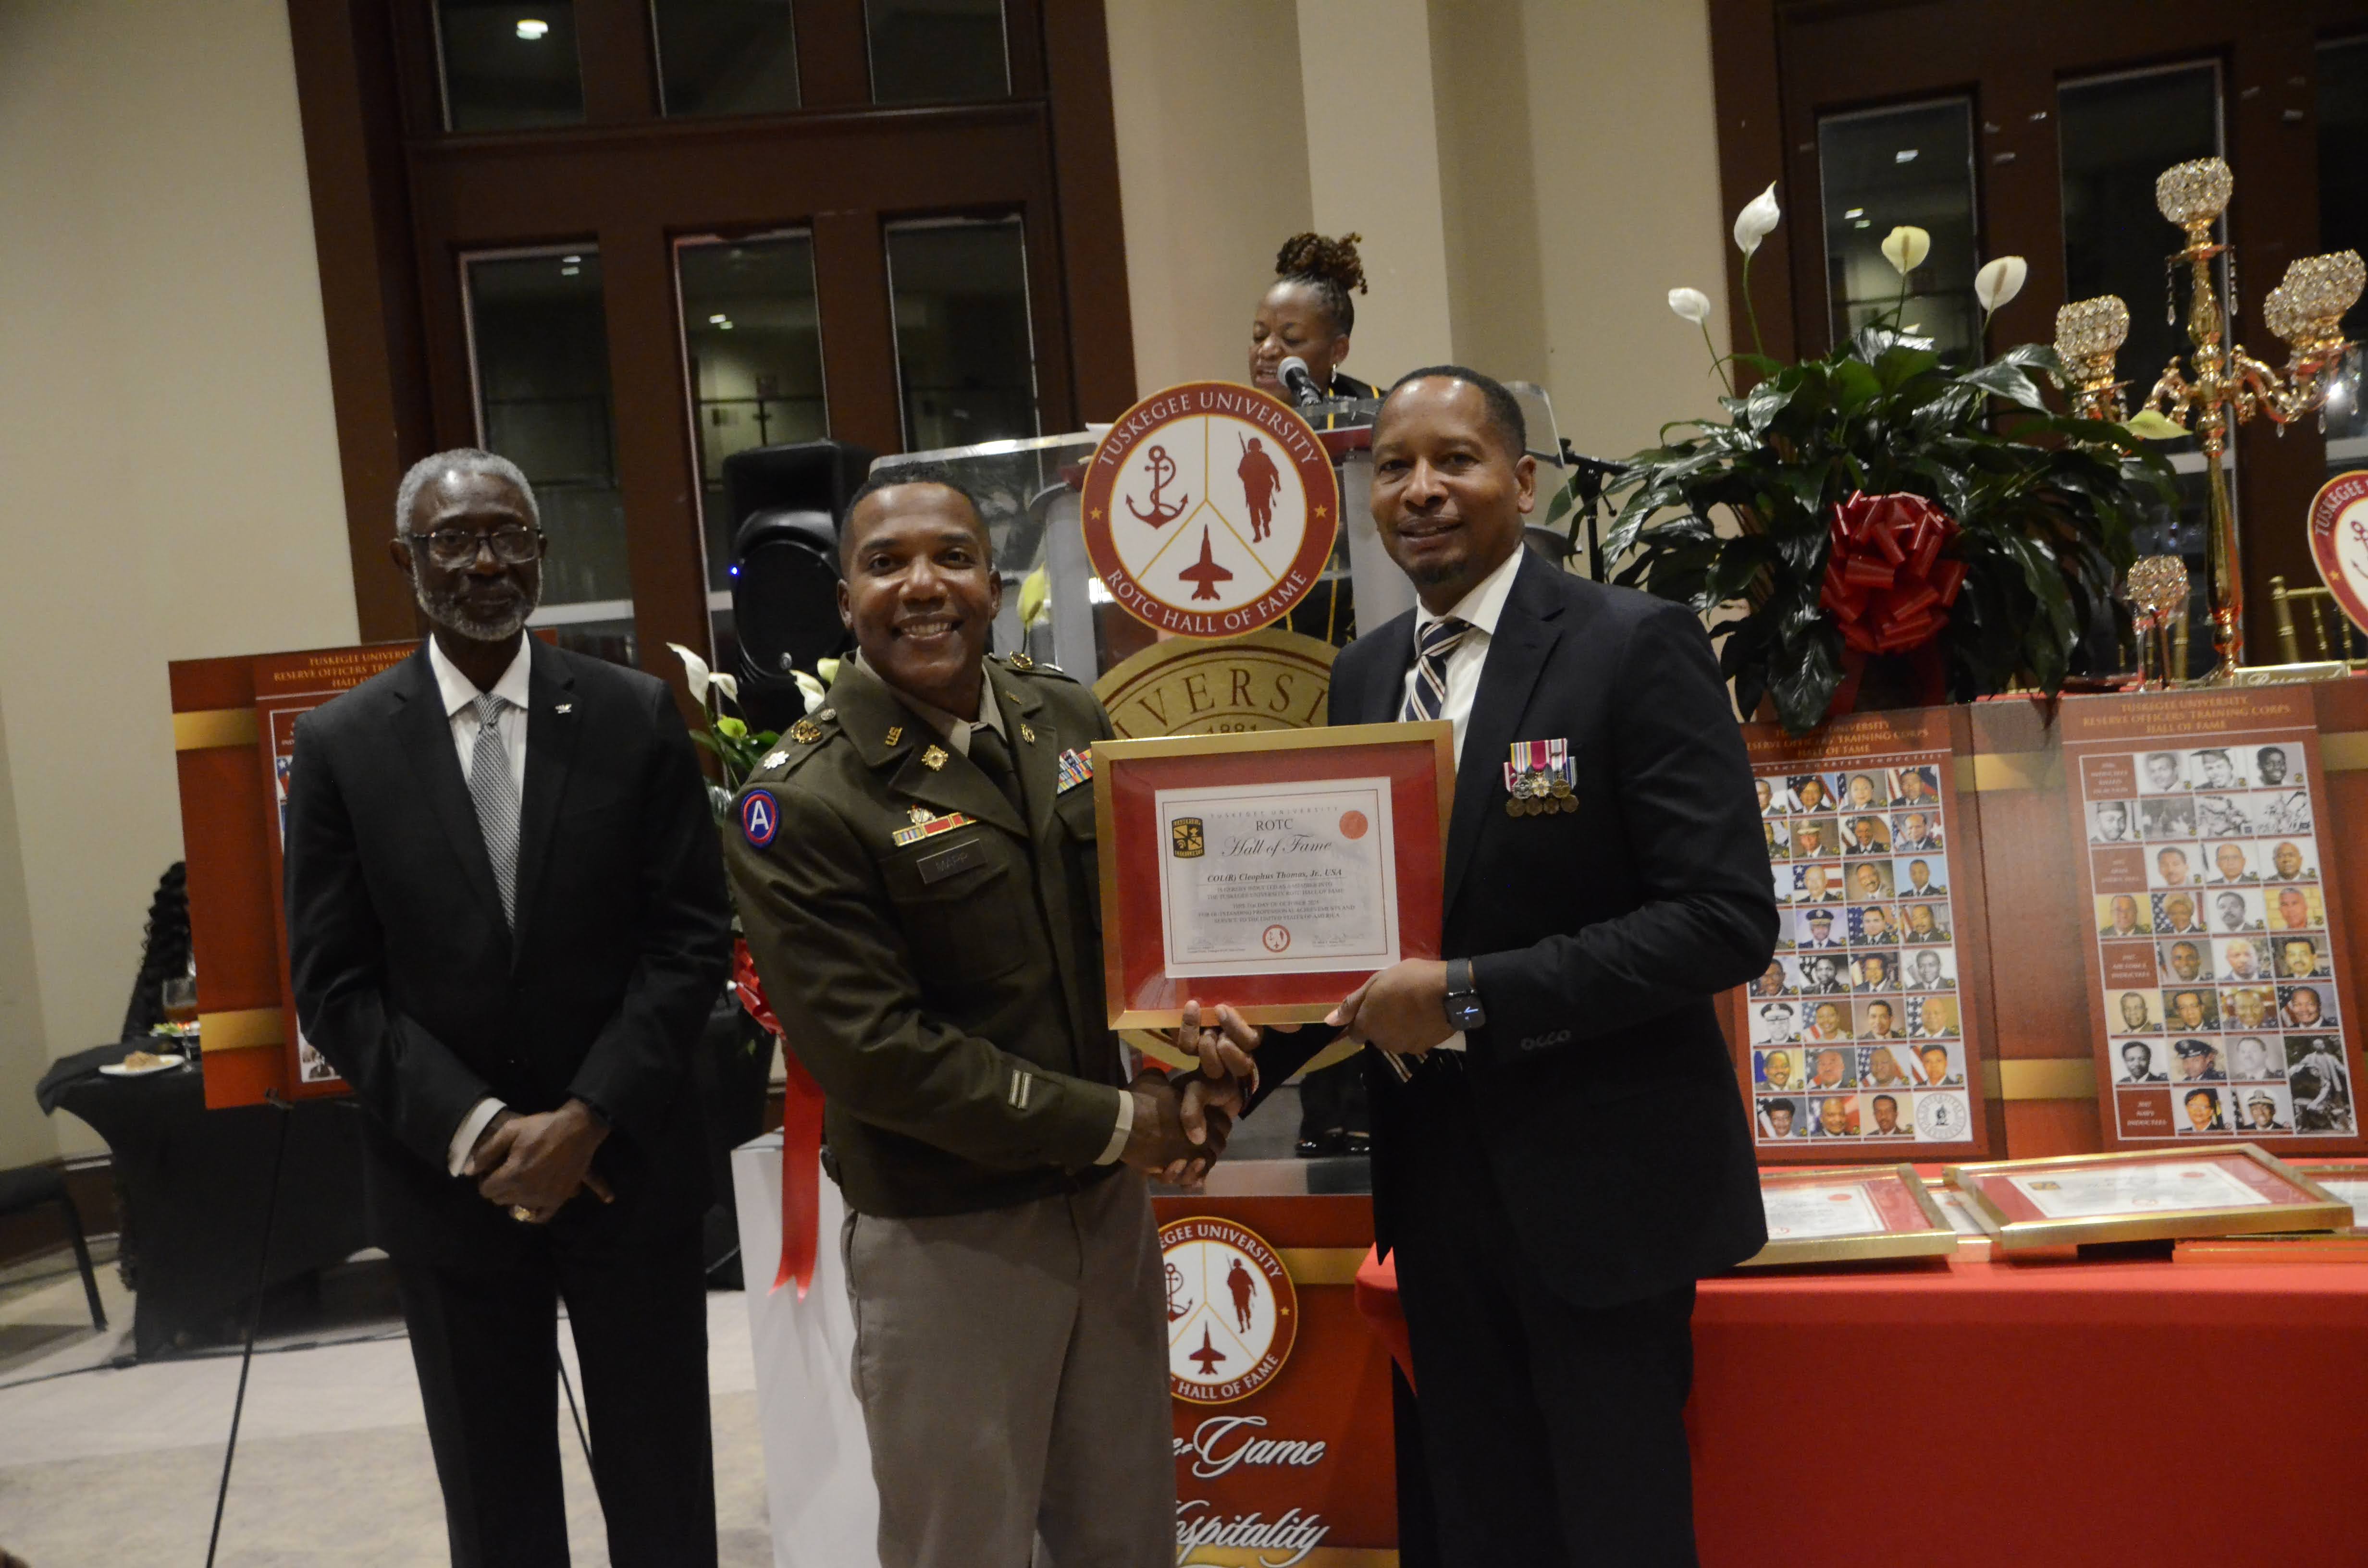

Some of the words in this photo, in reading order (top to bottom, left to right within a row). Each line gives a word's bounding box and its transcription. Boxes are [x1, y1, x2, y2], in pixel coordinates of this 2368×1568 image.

[1098, 393, 1191, 467] TUSKEGEE
[1200, 391, 1318, 464] UNIVERSITY
[2315, 479, 2365, 537] TUSKEGEE
[1108, 569, 1159, 620] ROTC
[1163, 609, 1217, 633] HALL
[1224, 610, 1252, 630] OF
[1256, 570, 1307, 618] FAME
[2180, 696, 2248, 708] UNIVERSITY
[2191, 708, 2249, 719] TRAINING
[2252, 703, 2292, 716] CORPS
[885, 726, 903, 746] US
[1838, 731, 1892, 744] TRAINING
[1826, 746, 1839, 755] OF
[1842, 744, 1871, 754] FAME
[751, 800, 769, 832] A
[1256, 819, 1294, 831] ROTC
[1221, 835, 1265, 857] Hall
[1266, 838, 1282, 857] of
[1283, 833, 1332, 854] Fame
[1207, 874, 1236, 883] COL(R)
[1239, 873, 1274, 882] Cleophus
[1276, 871, 1308, 880] Thomas,
[1197, 1224, 1283, 1278] UNIVERSITY
[1177, 1381, 1218, 1399] HALL
[1221, 1381, 1242, 1398] OF
[1243, 1353, 1279, 1388] FAME
